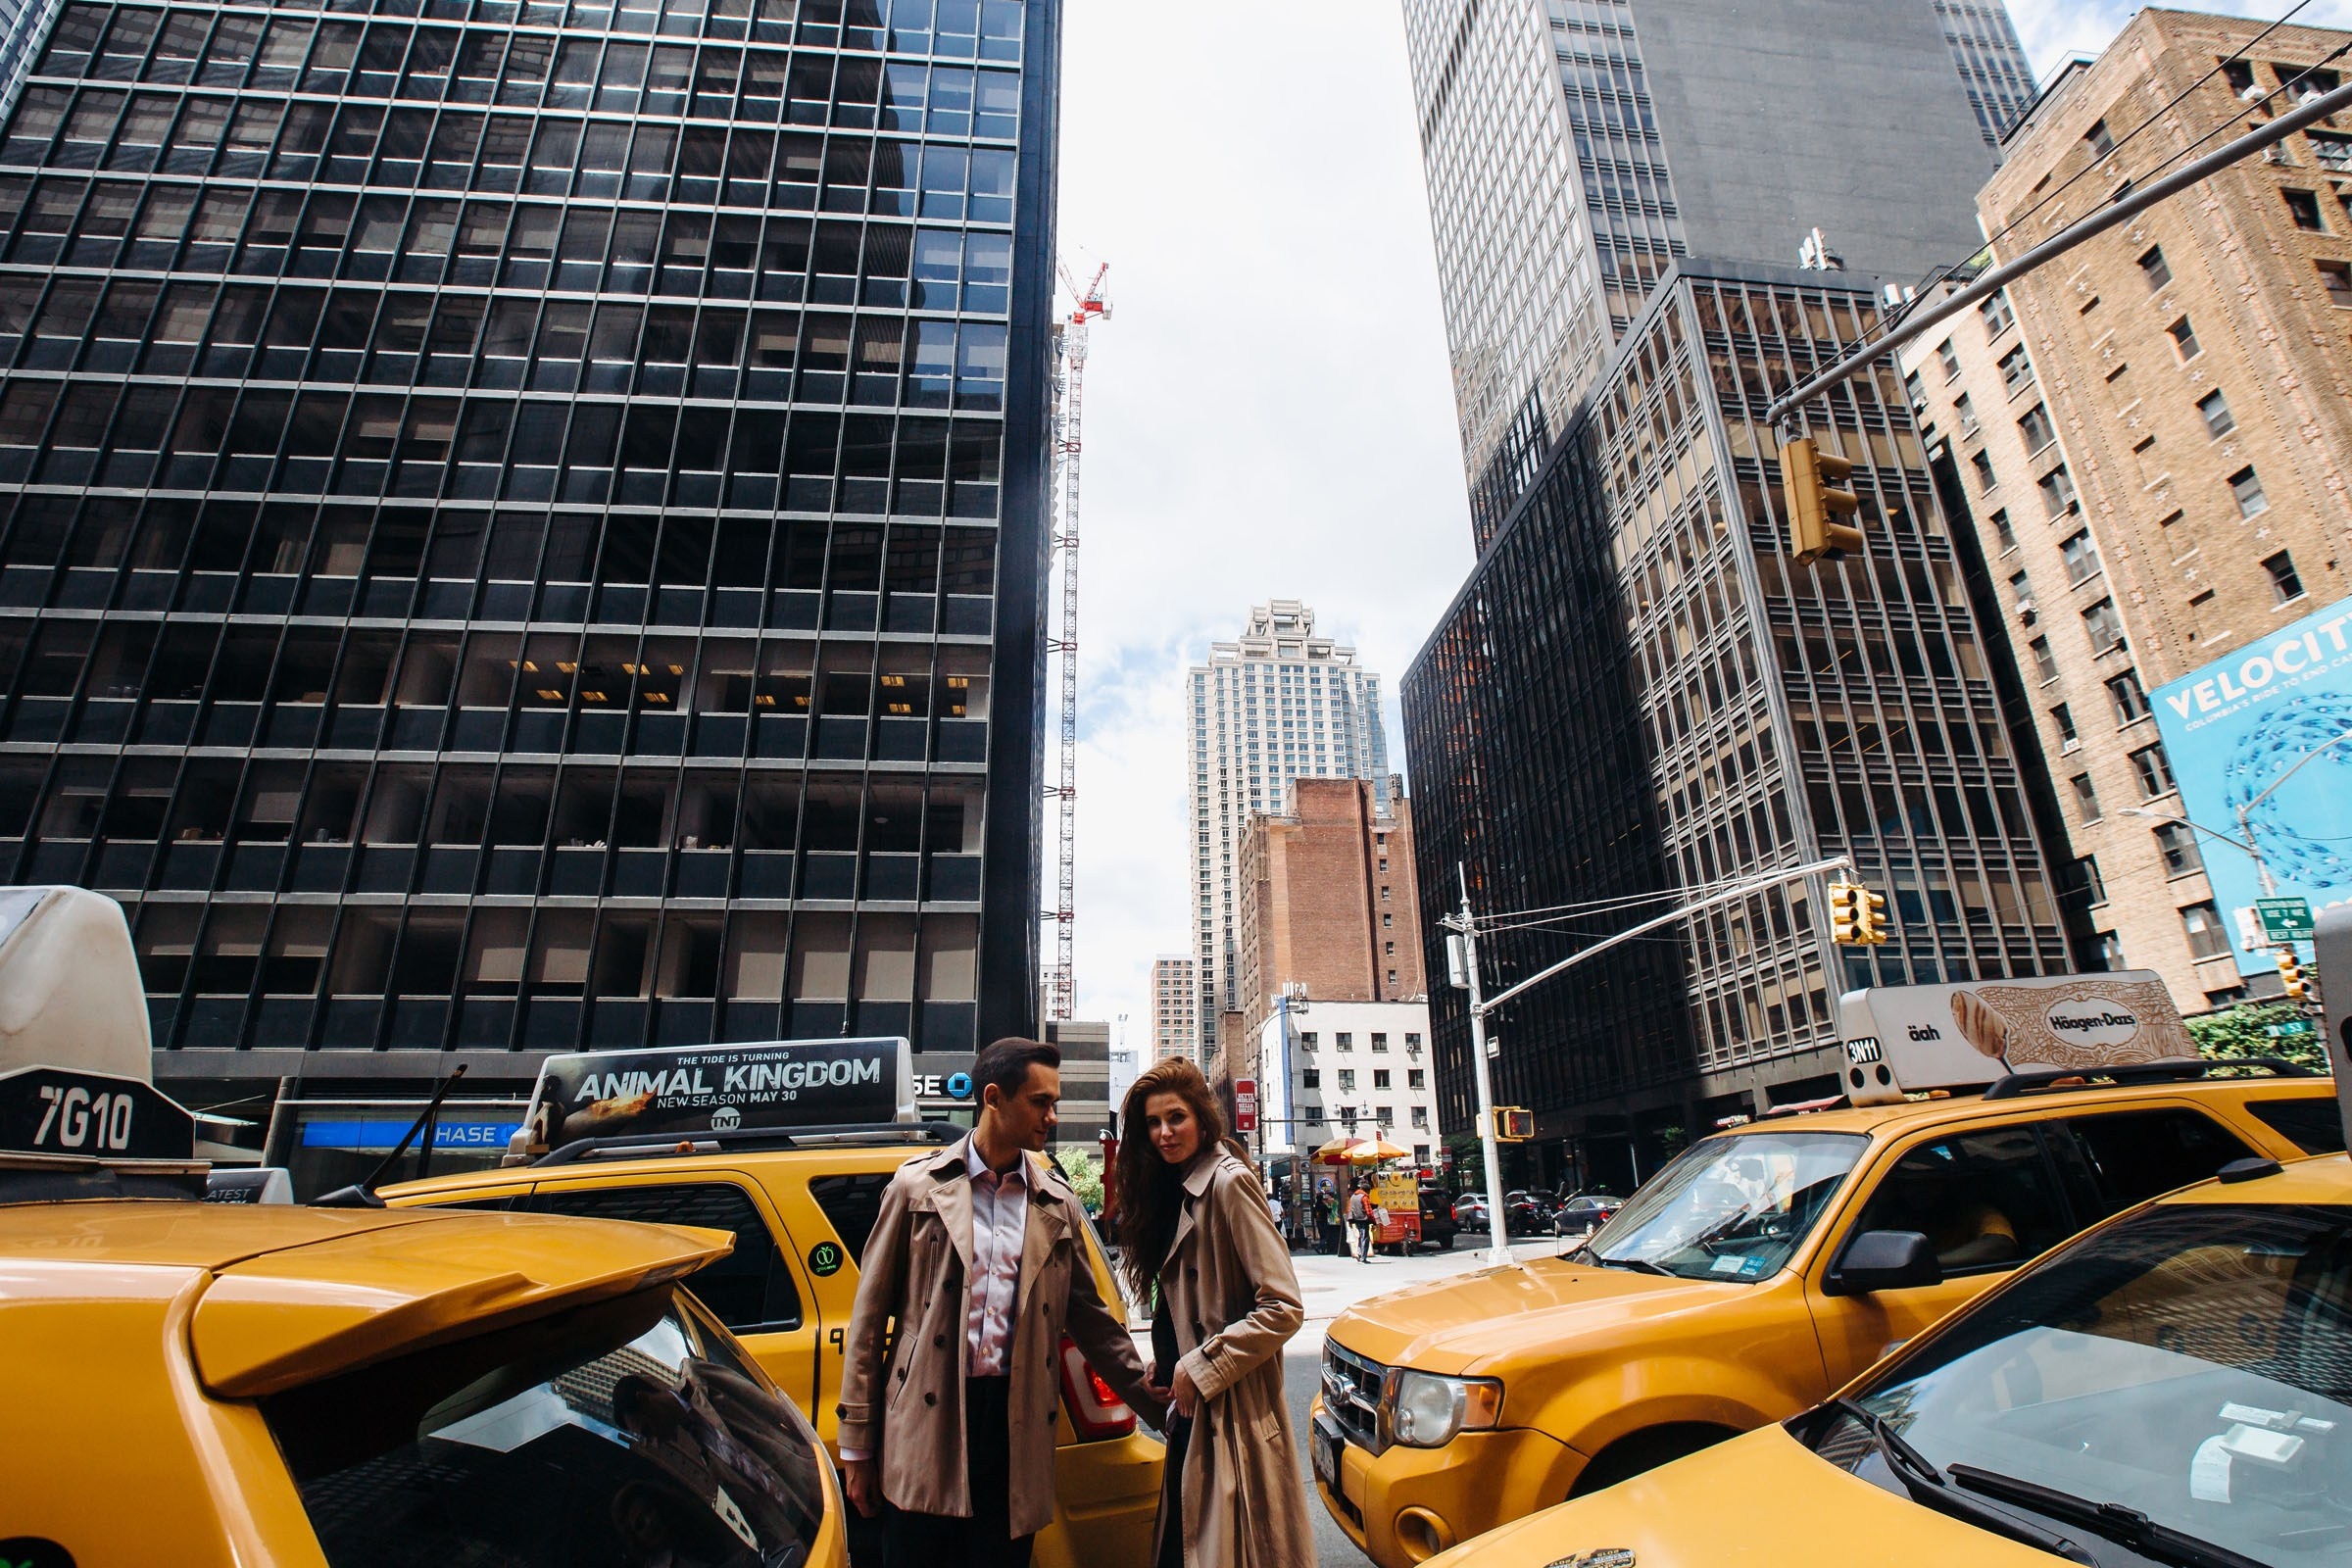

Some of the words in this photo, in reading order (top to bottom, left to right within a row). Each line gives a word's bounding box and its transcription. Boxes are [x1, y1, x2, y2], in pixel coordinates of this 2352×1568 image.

[2166, 612, 2352, 719] VELOCIT
[2184, 698, 2250, 732] COLUMBIA'S
[2251, 685, 2280, 704] RIDE
[2281, 677, 2300, 689] TO
[2302, 664, 2329, 681] END
[2331, 653, 2352, 668] CA
[2270, 931, 2290, 940] BEST
[2049, 1012, 2135, 1032] Häagen-Dazs
[1908, 1024, 1941, 1042] äah
[677, 1056, 700, 1066] THE
[701, 1054, 726, 1064] TIDE
[728, 1054, 739, 1063] IS
[742, 1052, 790, 1062] TURNING
[1847, 1037, 1881, 1063] 3N11
[574, 1067, 714, 1102] ANIMAL
[723, 1057, 881, 1093] KINGDOM
[657, 1096, 689, 1108] NEW
[691, 1093, 746, 1106] SEASON
[750, 1091, 780, 1103] MAY
[781, 1090, 798, 1102] 30
[33, 1085, 133, 1151] 7G10
[201, 1189, 251, 1200] ATEST
